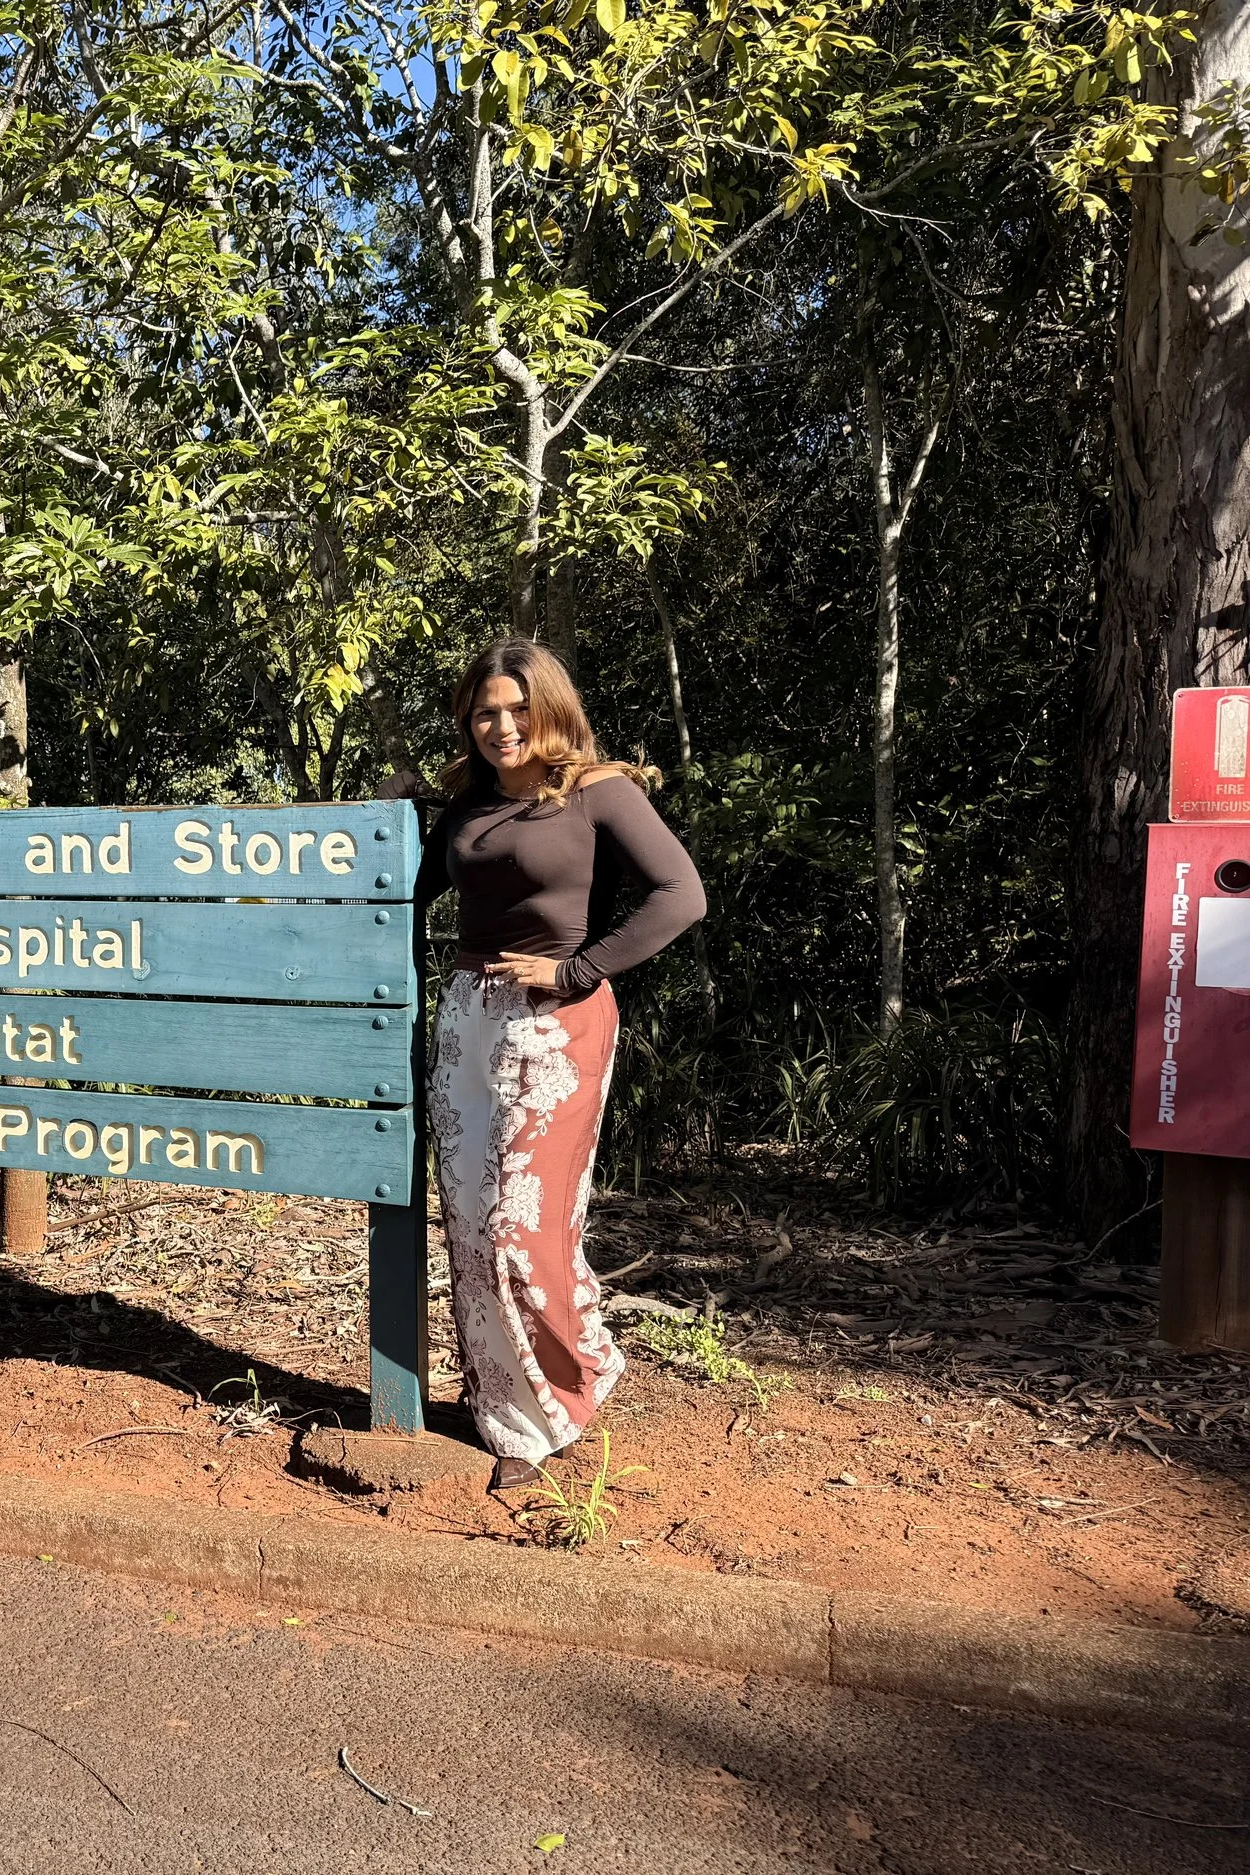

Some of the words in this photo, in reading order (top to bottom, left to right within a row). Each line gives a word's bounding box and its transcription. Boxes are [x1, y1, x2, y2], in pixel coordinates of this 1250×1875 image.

[1216, 784, 1245, 795] FIRE
[24, 820, 132, 875] and
[173, 820, 358, 876] Store
[1171, 862, 1191, 926] FIRE
[1158, 932, 1186, 1124] EXTINGUISHER
